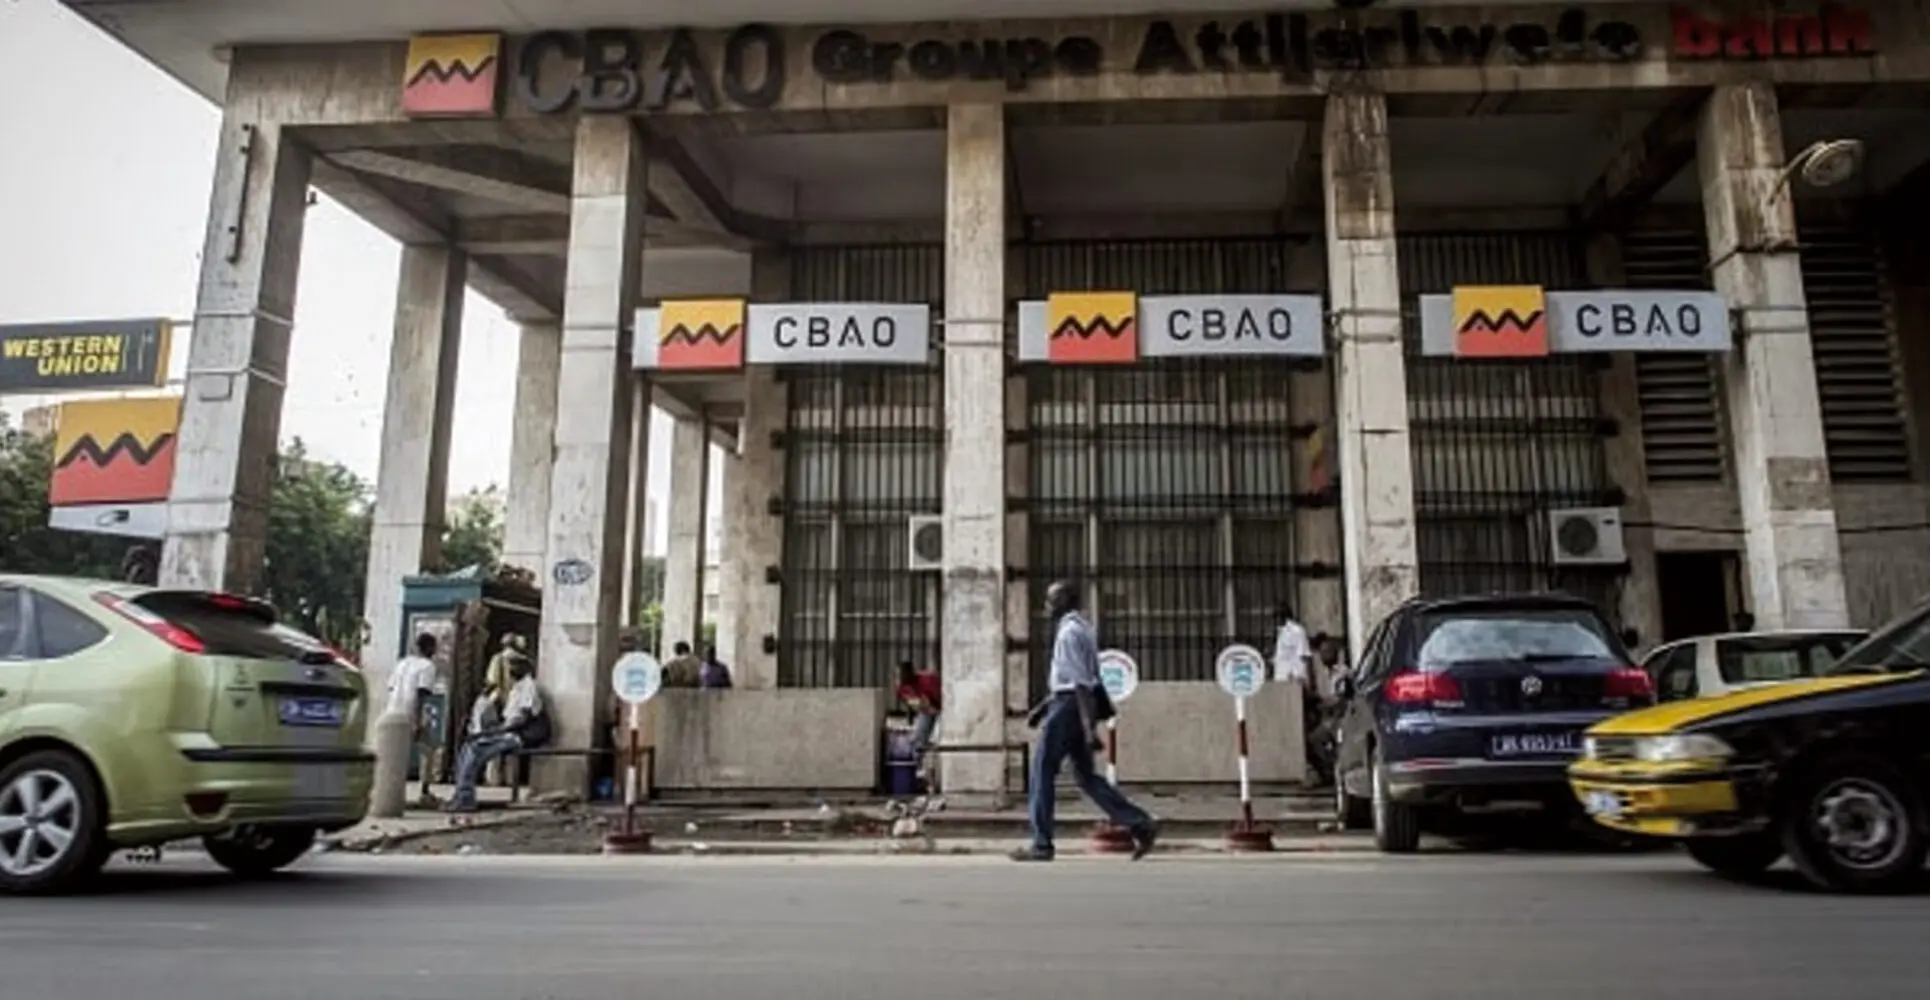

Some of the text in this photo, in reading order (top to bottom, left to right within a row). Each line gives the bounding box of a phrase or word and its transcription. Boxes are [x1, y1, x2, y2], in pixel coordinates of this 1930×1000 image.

[516, 25, 786, 114] CBAO
[812, 29, 1102, 91] Groupe
[1670, 4, 1876, 59] bank
[772, 316, 897, 349] CBAO
[1166, 308, 1293, 342] CBAO
[1575, 303, 1702, 337] CBAO
[3, 335, 122, 358] WESTERN
[37, 355, 120, 376] UNION
